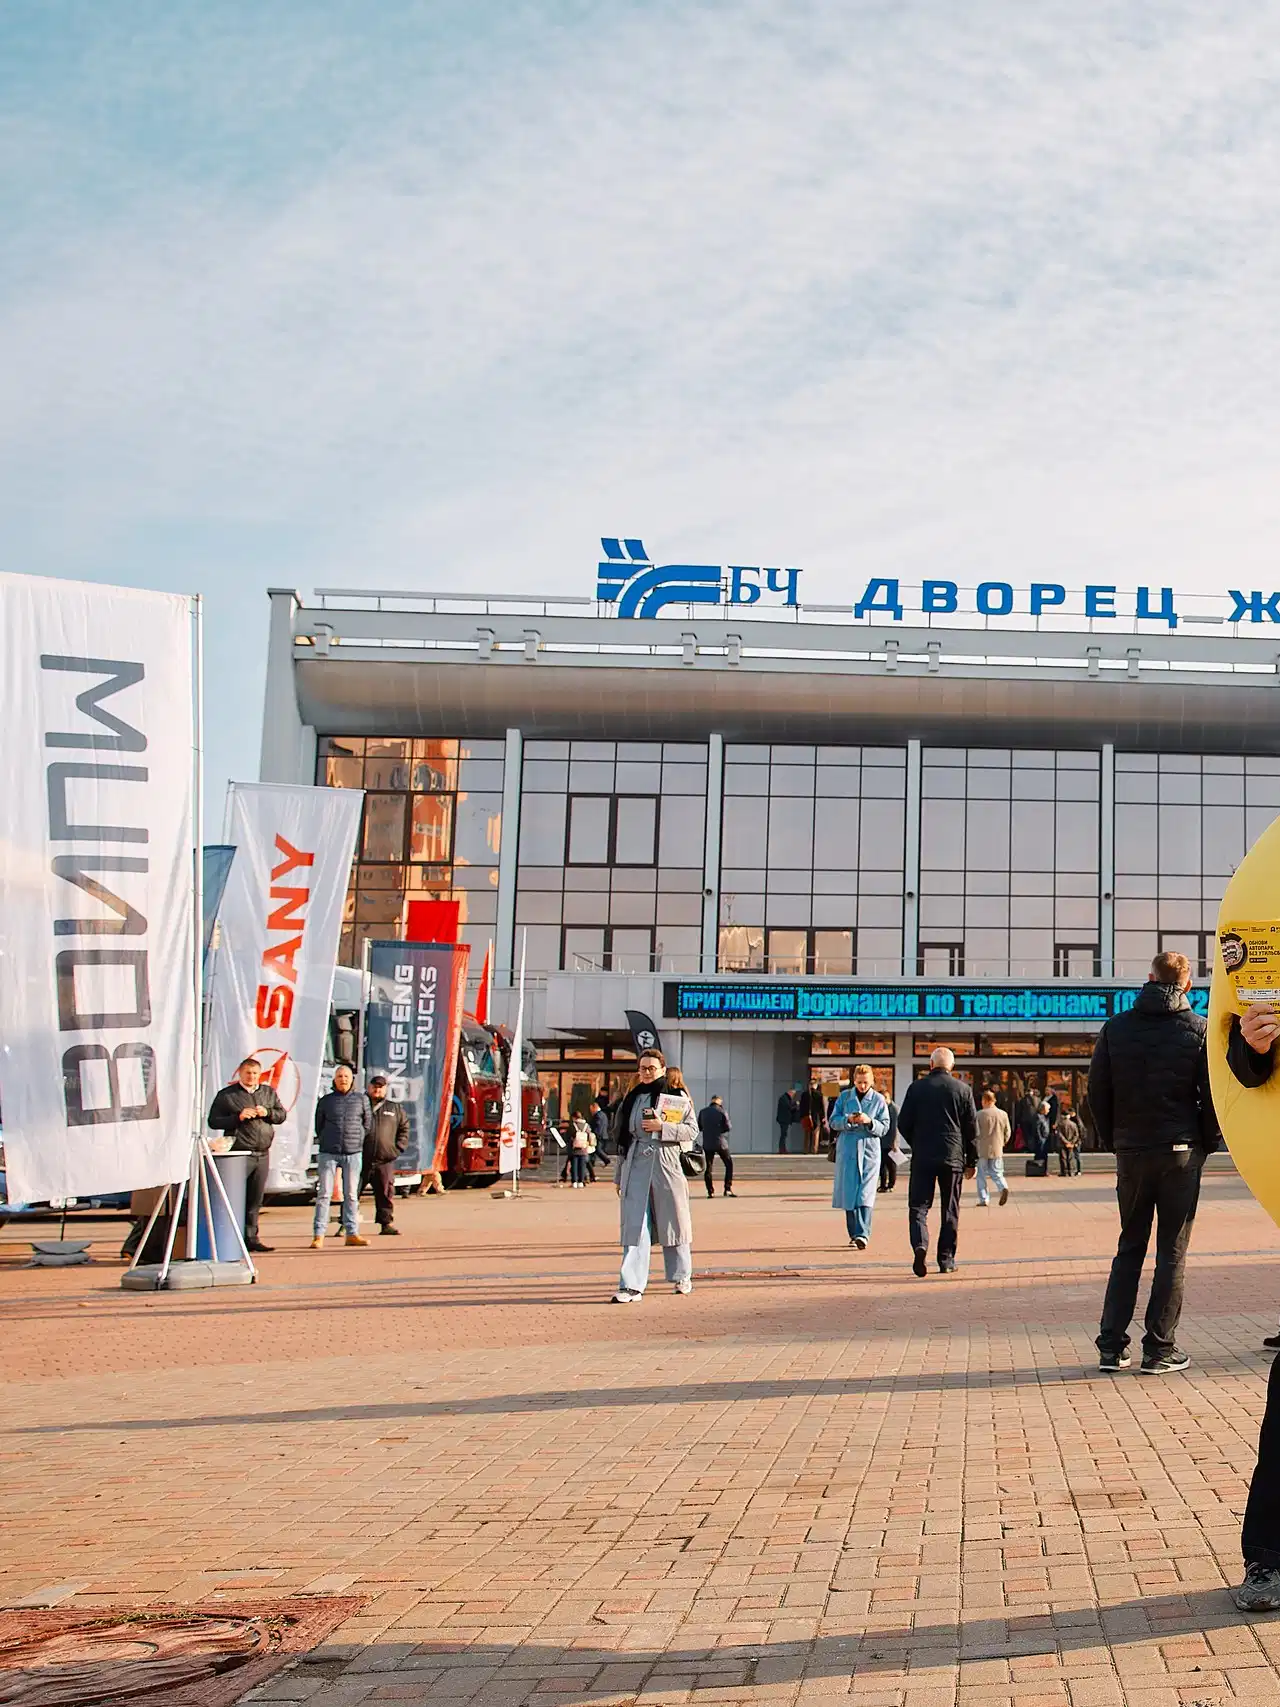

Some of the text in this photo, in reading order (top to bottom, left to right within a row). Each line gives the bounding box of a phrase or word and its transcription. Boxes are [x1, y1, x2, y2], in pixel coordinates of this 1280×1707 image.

[728, 565, 802, 607] БЧ
[854, 577, 1178, 628] ДВОРЕЦ
[255, 832, 315, 1029] SANY
[385, 964, 414, 1103] ONGFENG
[414, 966, 437, 1065] TRUCKS
[681, 991, 795, 1012] ПРИГЛАШАЕМ
[925, 993, 955, 1016] по
[960, 990, 1107, 1019] телефонам:
